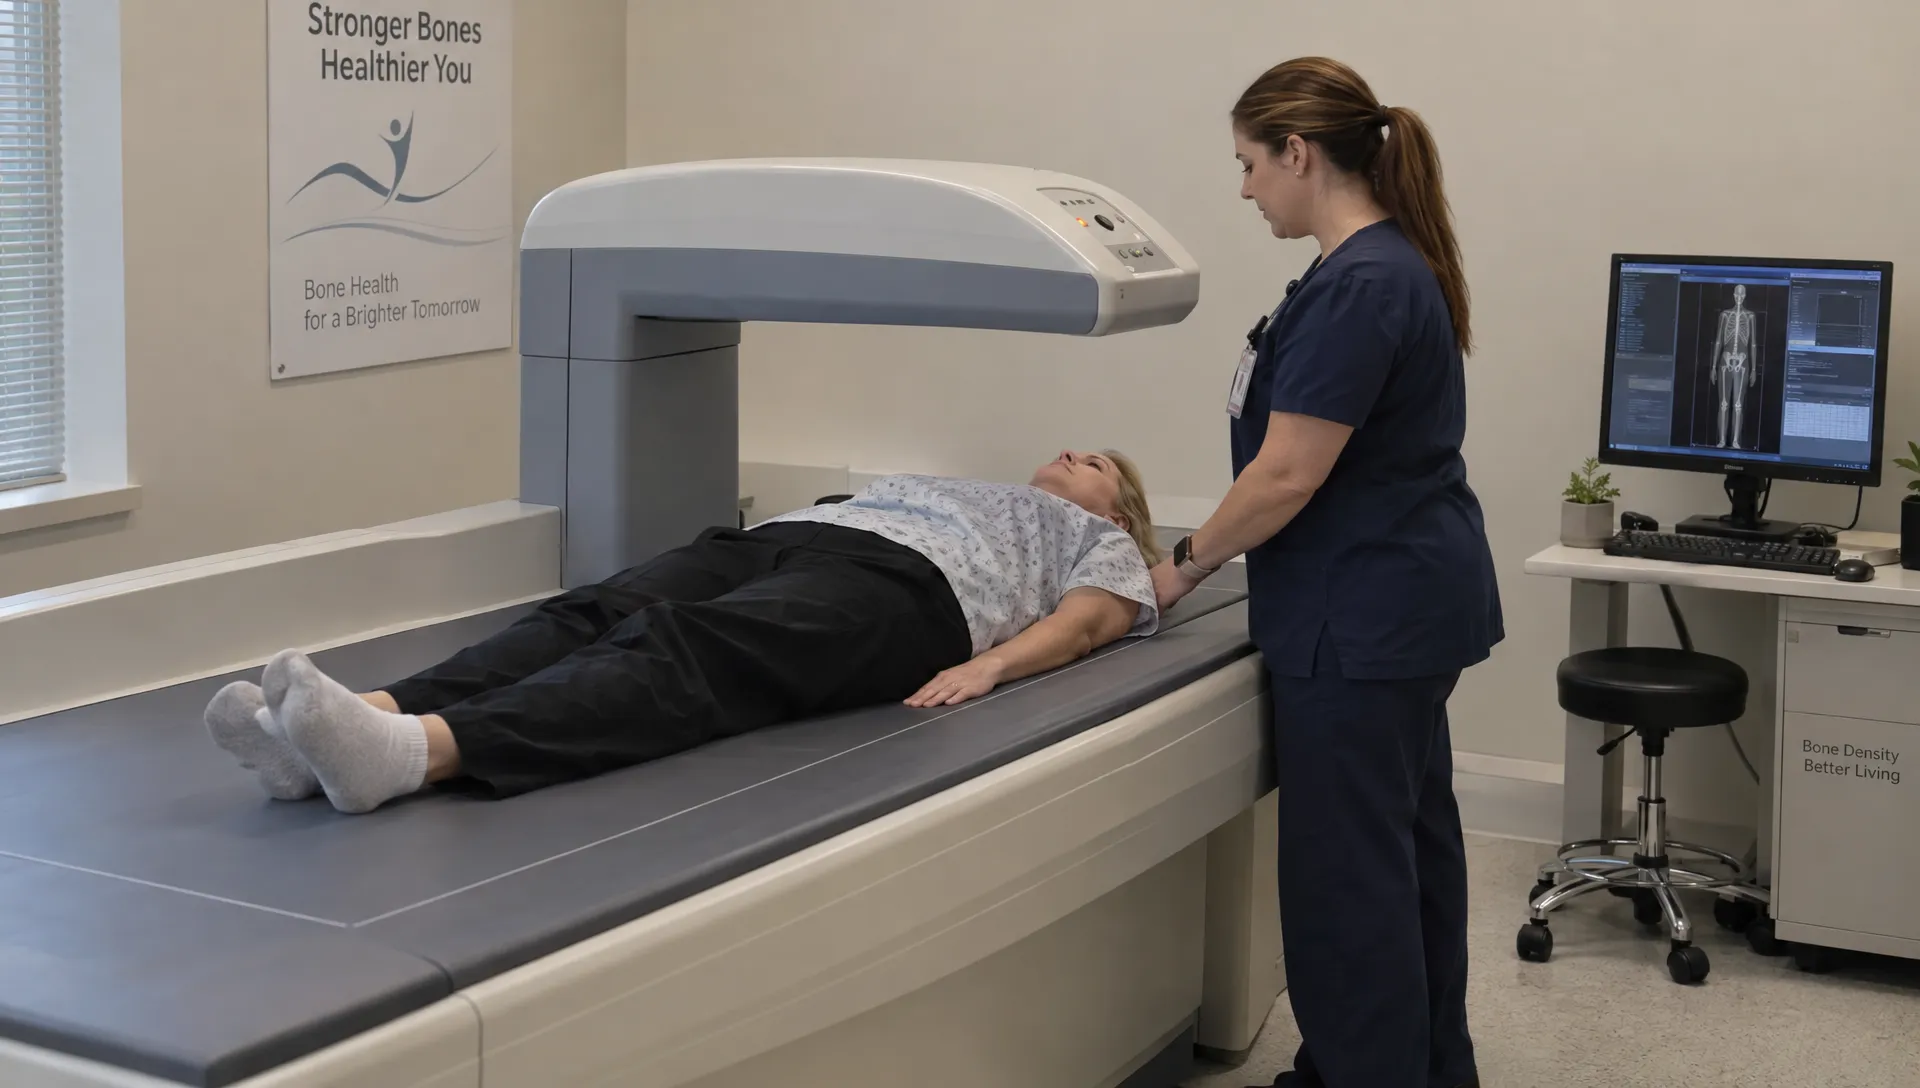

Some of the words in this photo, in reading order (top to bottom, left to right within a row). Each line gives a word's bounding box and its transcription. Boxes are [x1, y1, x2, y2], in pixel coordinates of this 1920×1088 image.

[308, 2, 412, 46] Stronger
[418, 11, 482, 44] Bones
[321, 48, 429, 83] Healthier
[434, 53, 472, 84] You
[304, 279, 346, 300] Bone
[350, 272, 399, 297] Health
[304, 309, 327, 331] for
[331, 313, 341, 328] a
[346, 304, 407, 329] Brighter
[411, 298, 481, 319] Tomorrow
[1802, 739, 1840, 755] Bone
[1843, 744, 1900, 765] Density
[1804, 758, 1851, 776] Better
[1855, 764, 1900, 785] Living
